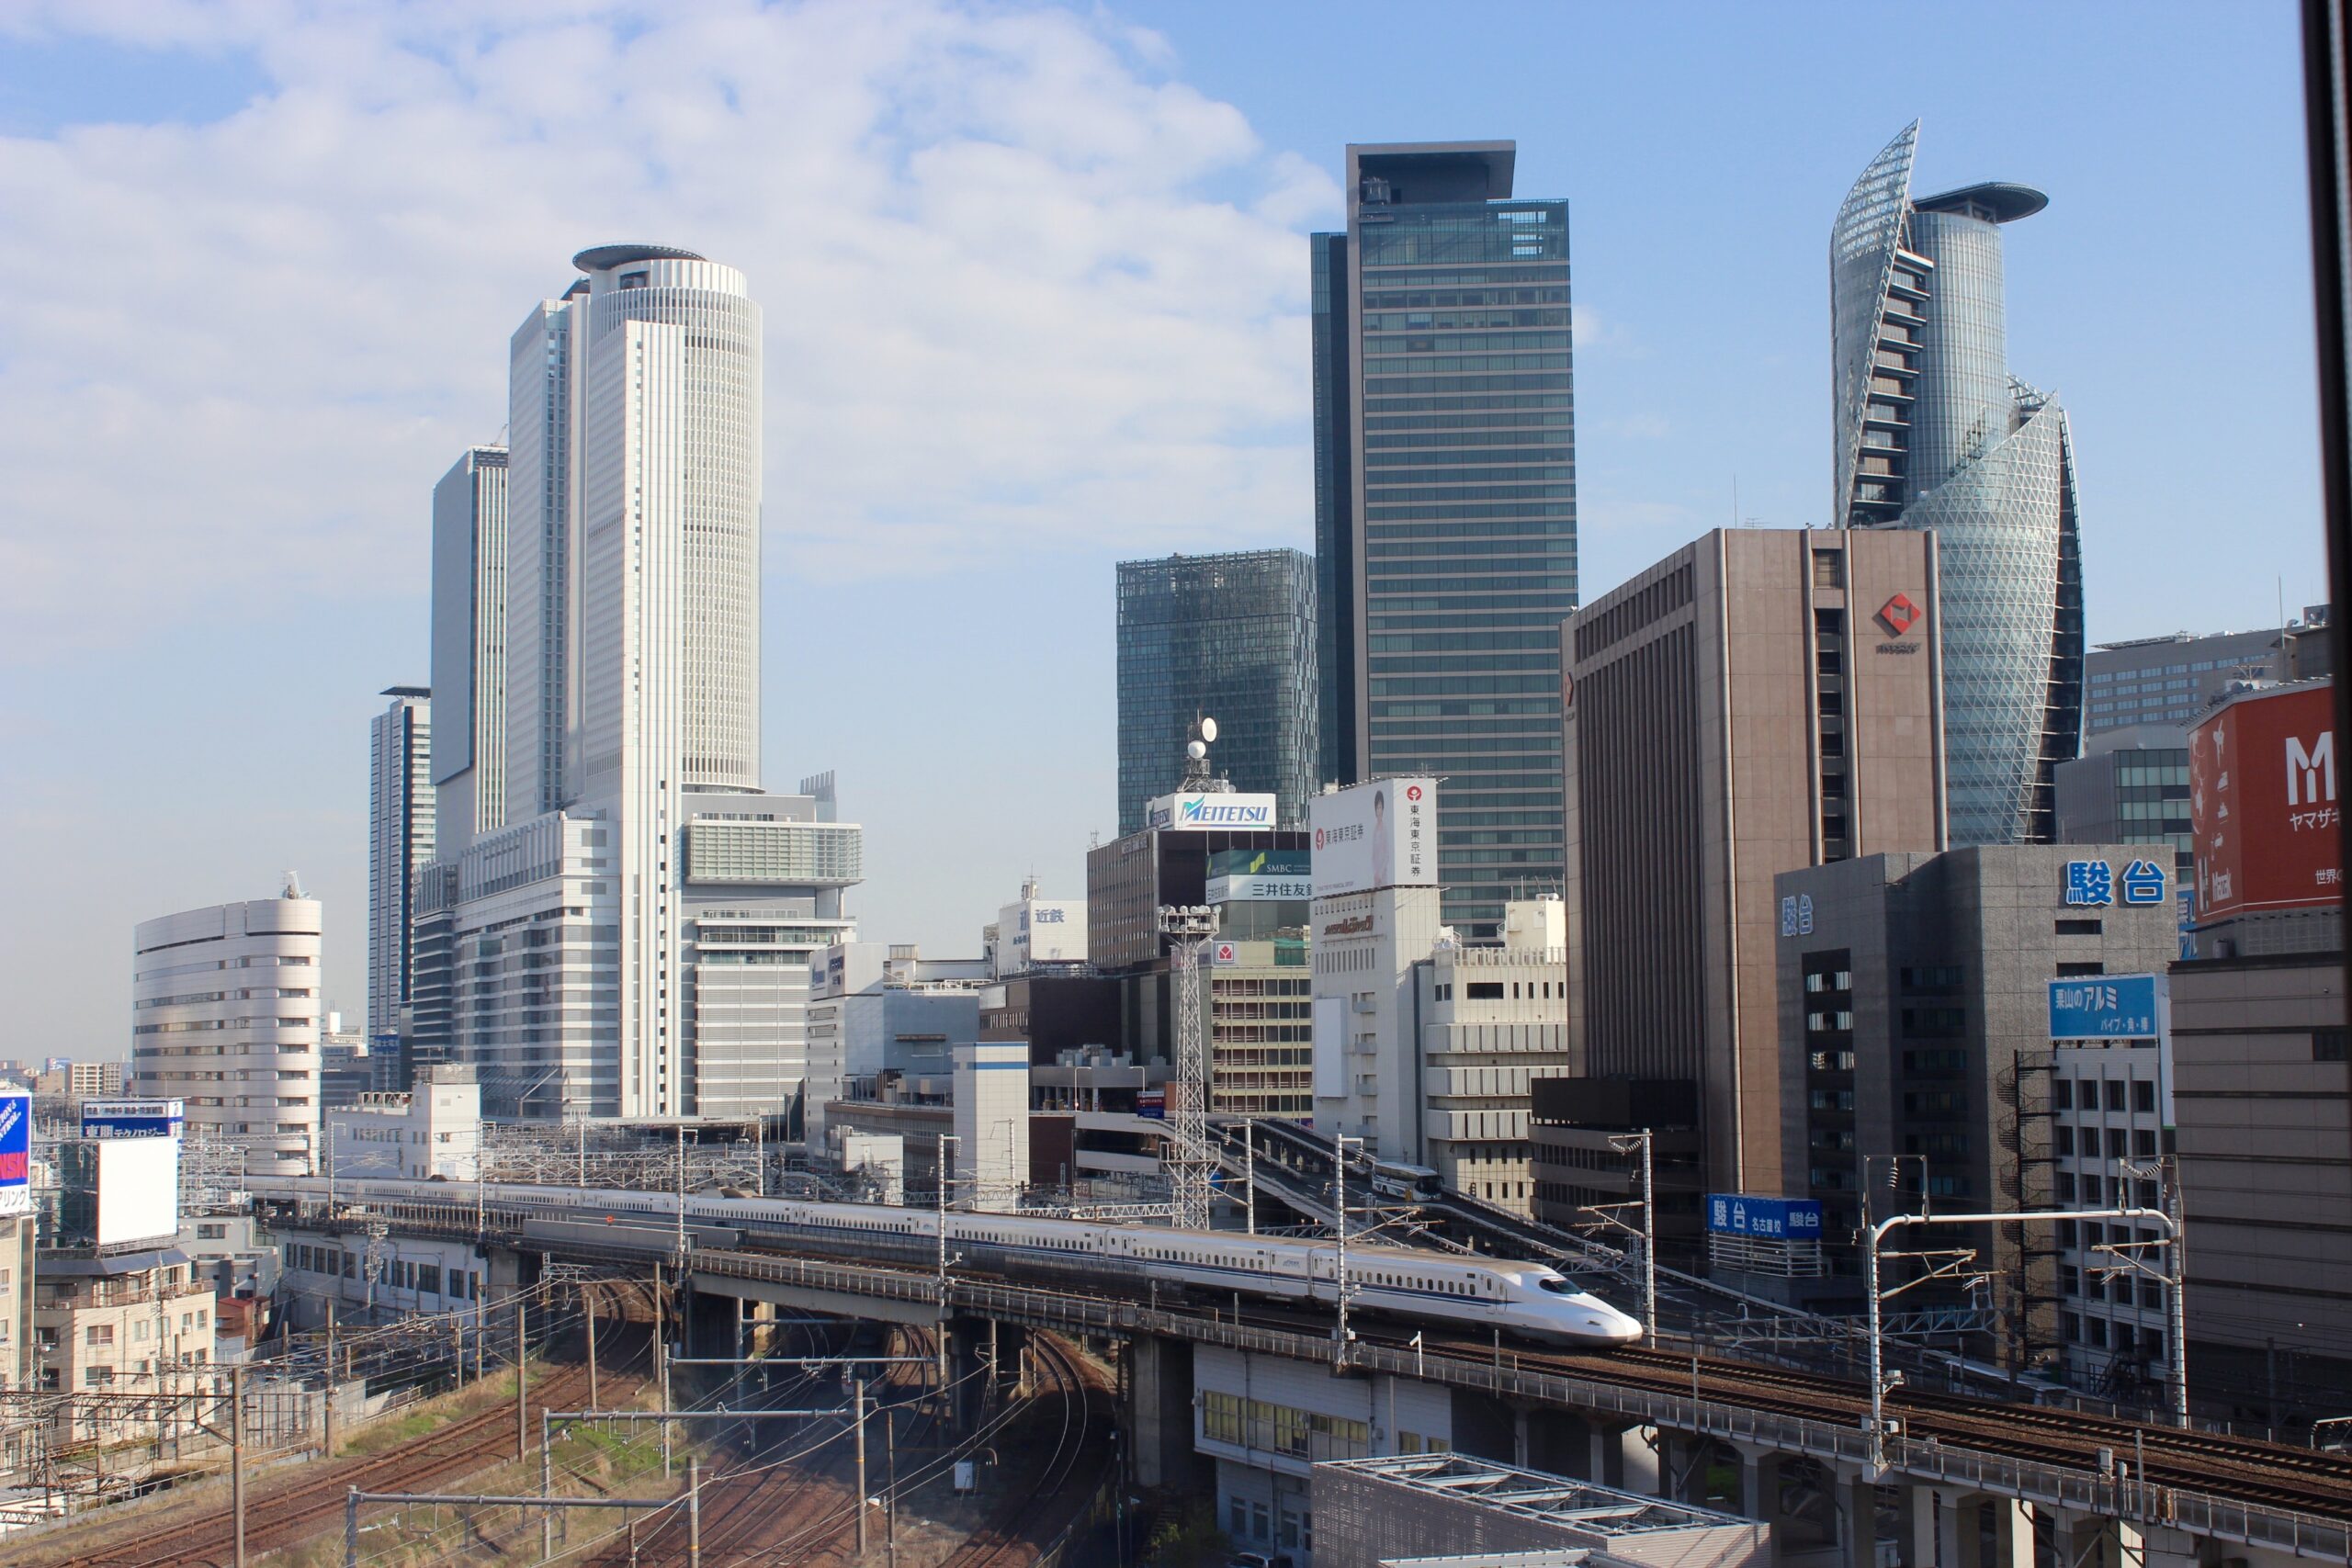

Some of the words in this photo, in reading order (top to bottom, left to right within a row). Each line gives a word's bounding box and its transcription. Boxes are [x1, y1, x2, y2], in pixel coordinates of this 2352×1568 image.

[1180, 795, 1268, 822] MEITETSU
[1326, 823, 1364, 845] 東海東京証券
[1409, 805, 1421, 877] 東海東京証券
[1266, 864, 1293, 873] SMBC
[2065, 859, 2166, 905] 駿台
[1035, 908, 1064, 923] 近鉄
[1782, 894, 1814, 937] 駿台
[0, 1151, 28, 1180] NSK
[0, 1187, 27, 1208] リング
[1713, 1200, 1745, 1229] 駿台
[1752, 1217, 1781, 1233] 名古屋校
[1789, 1212, 1818, 1227] 駿台
